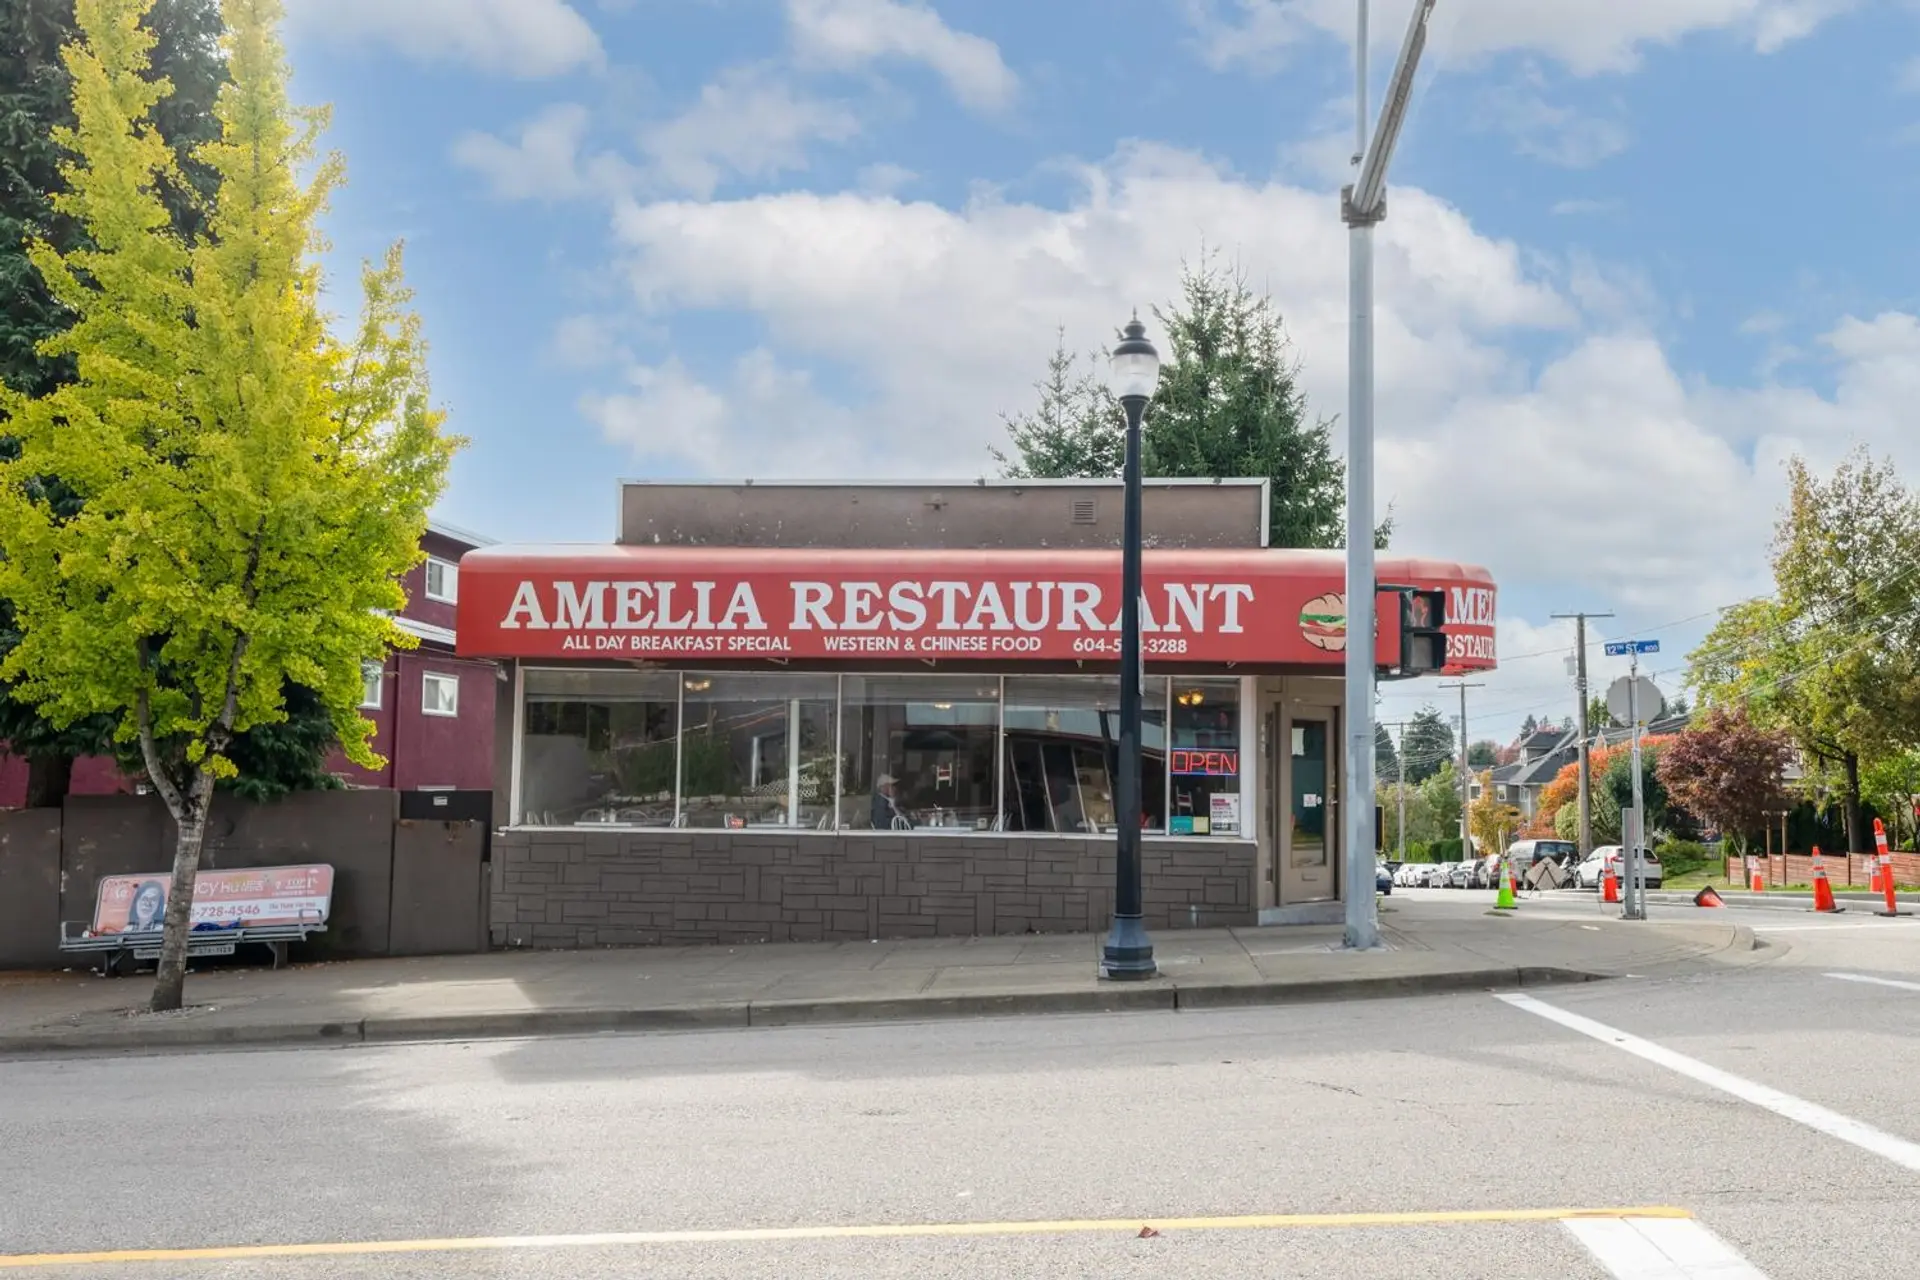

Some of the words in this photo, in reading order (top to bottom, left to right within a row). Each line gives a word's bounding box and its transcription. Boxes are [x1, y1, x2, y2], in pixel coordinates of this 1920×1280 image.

[500, 580, 768, 630] AMELIA
[788, 580, 1255, 633] RESTAURANT
[563, 635, 591, 650] ALL
[595, 635, 626, 650] DAY
[631, 635, 724, 651] BREAKFAST
[727, 636, 792, 651] SPECIAL
[823, 636, 899, 651] WESTERN
[903, 636, 916, 651] &
[920, 636, 988, 652] CHINESE
[991, 636, 1042, 652] FOOD
[1072, 637, 1188, 654] 604-5-3288
[1172, 751, 1237, 774] OPEN
